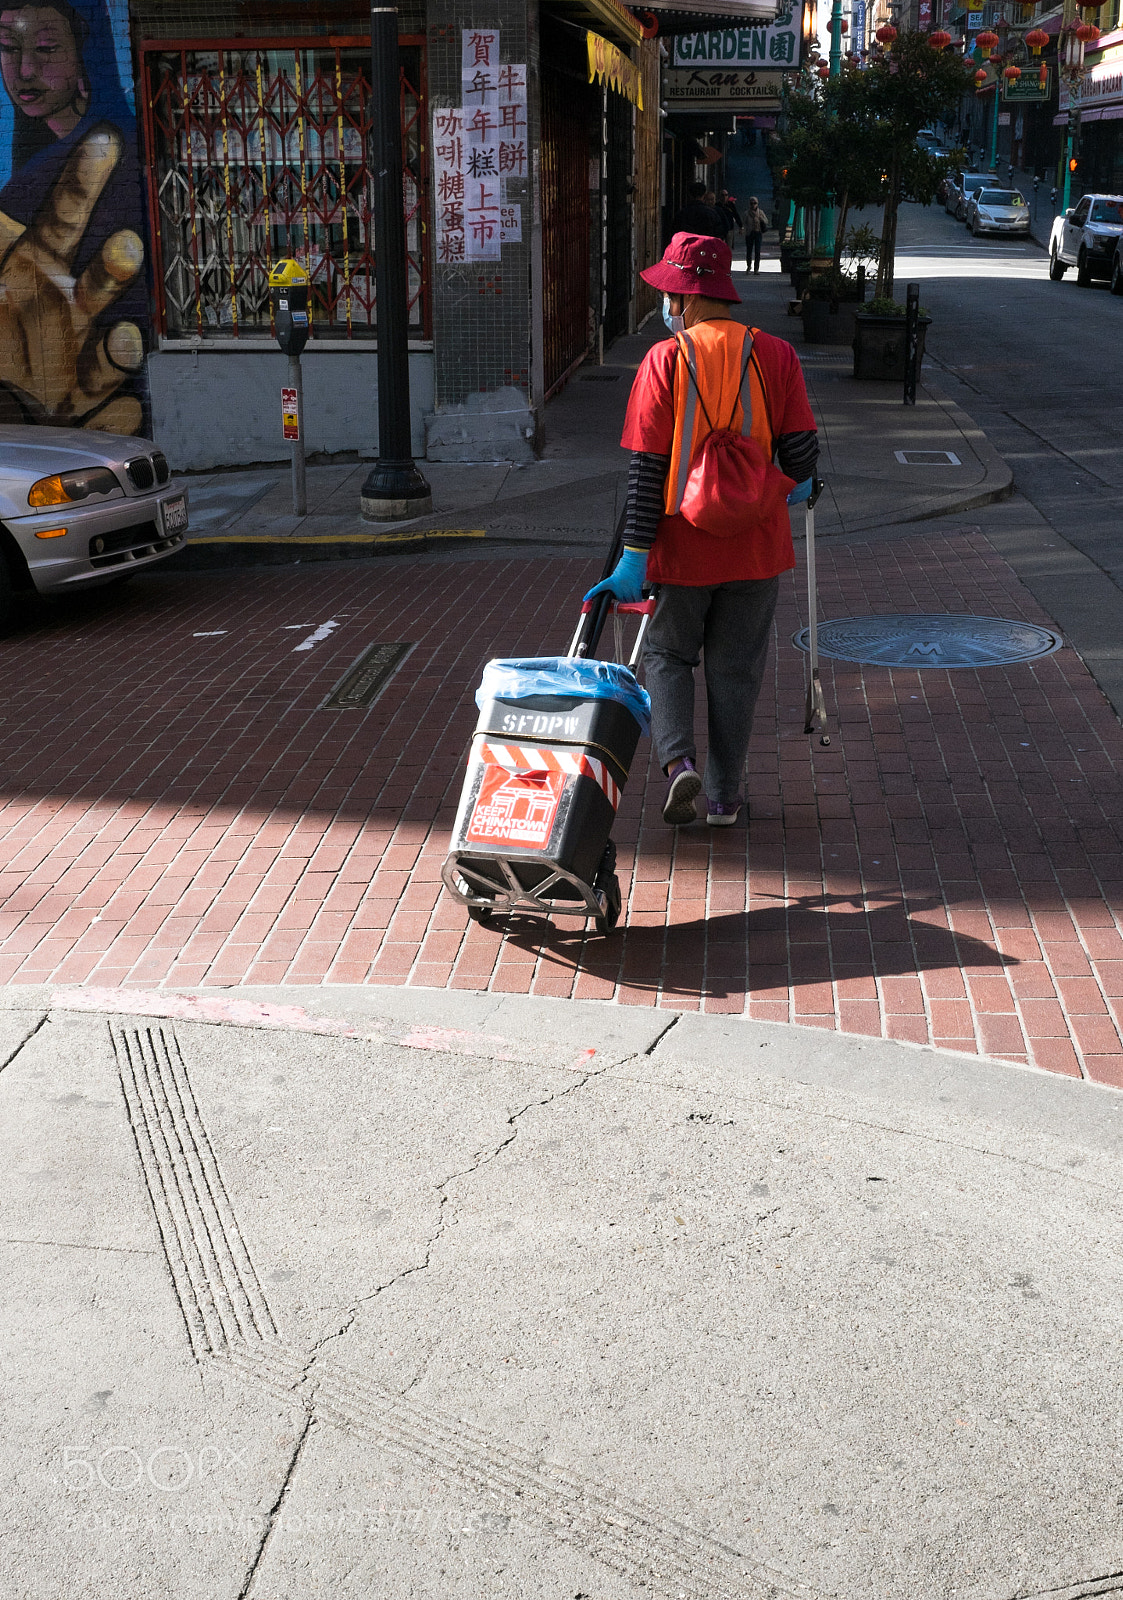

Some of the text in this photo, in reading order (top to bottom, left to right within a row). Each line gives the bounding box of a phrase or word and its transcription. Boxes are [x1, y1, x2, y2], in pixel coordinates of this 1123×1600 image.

[677, 30, 767, 60] GARDEN
[669, 86, 775, 96] RESTAURANT COCKTAILS
[498, 65, 527, 176] 牛耳餅
[465, 32, 499, 249] 賀年年糕上市
[503, 713, 579, 735] SFDPW
[476, 804, 506, 817] KEEP
[470, 825, 511, 838] CLEAN
[473, 815, 549, 832] CHINATOWN
